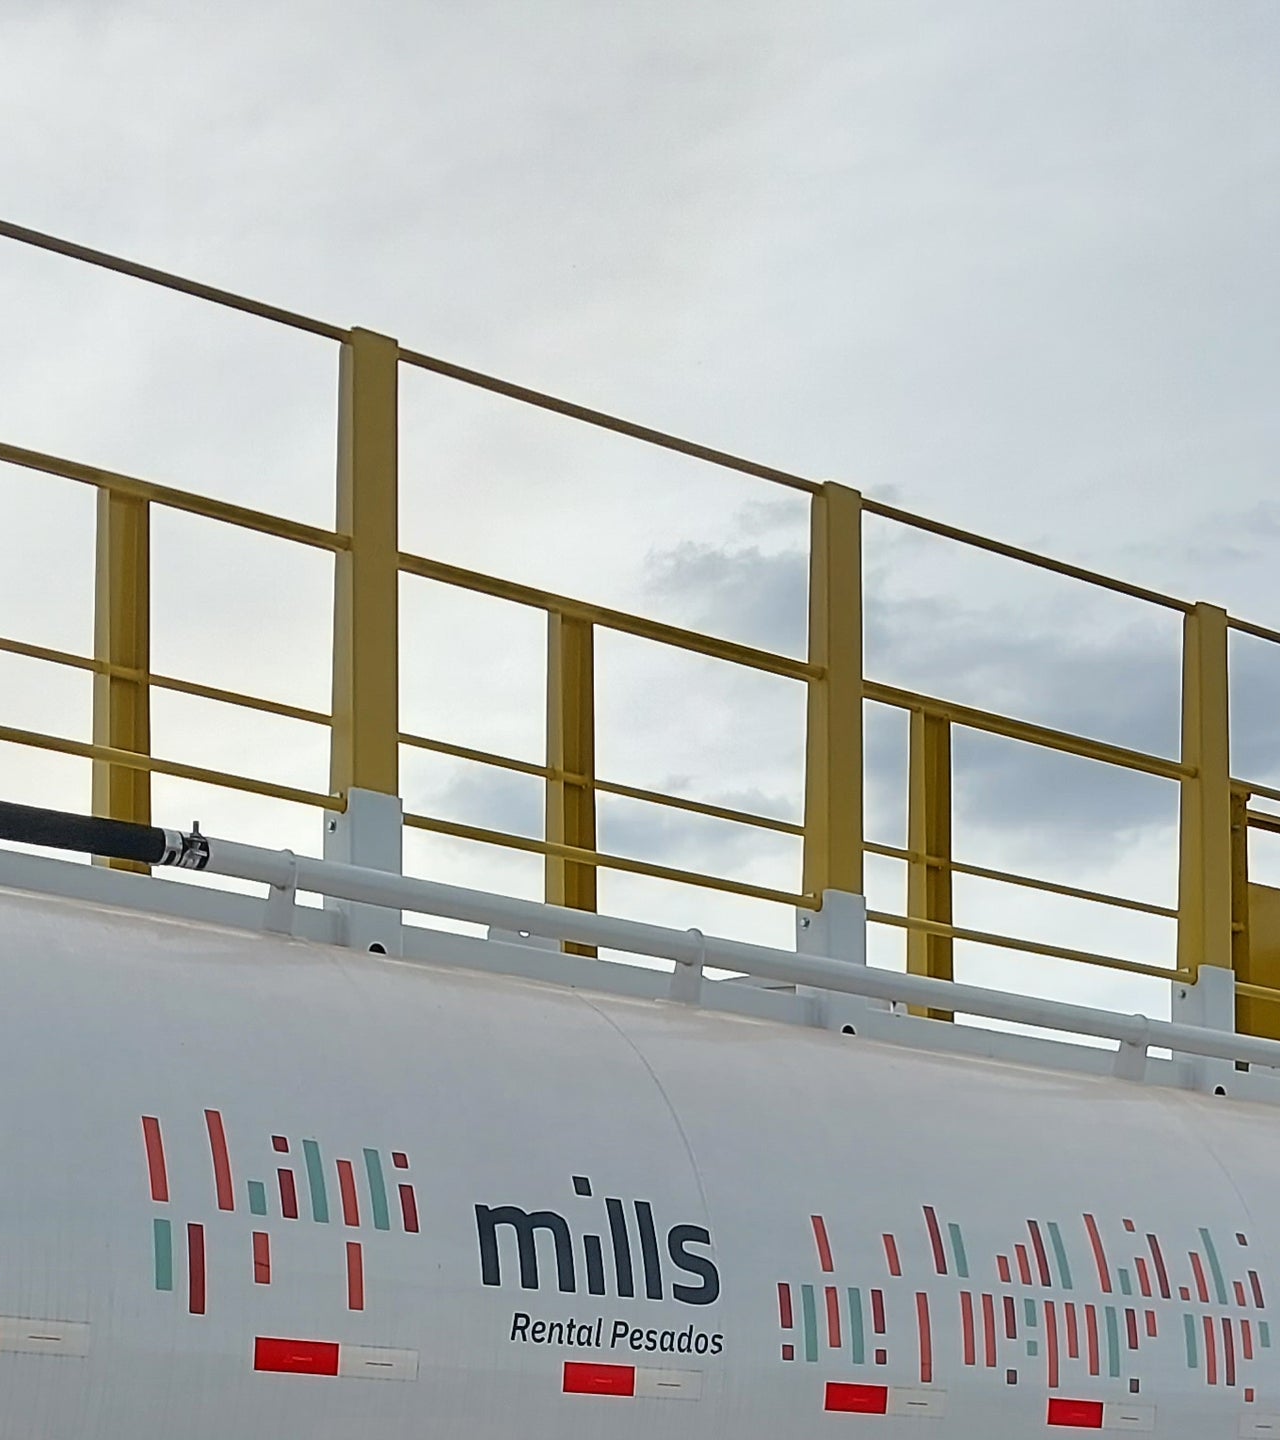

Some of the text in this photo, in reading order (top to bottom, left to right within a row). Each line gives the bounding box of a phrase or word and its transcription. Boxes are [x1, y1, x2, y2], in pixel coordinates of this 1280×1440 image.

[475, 1176, 719, 1305] mills
[510, 1312, 724, 1354] Rental Pesados
